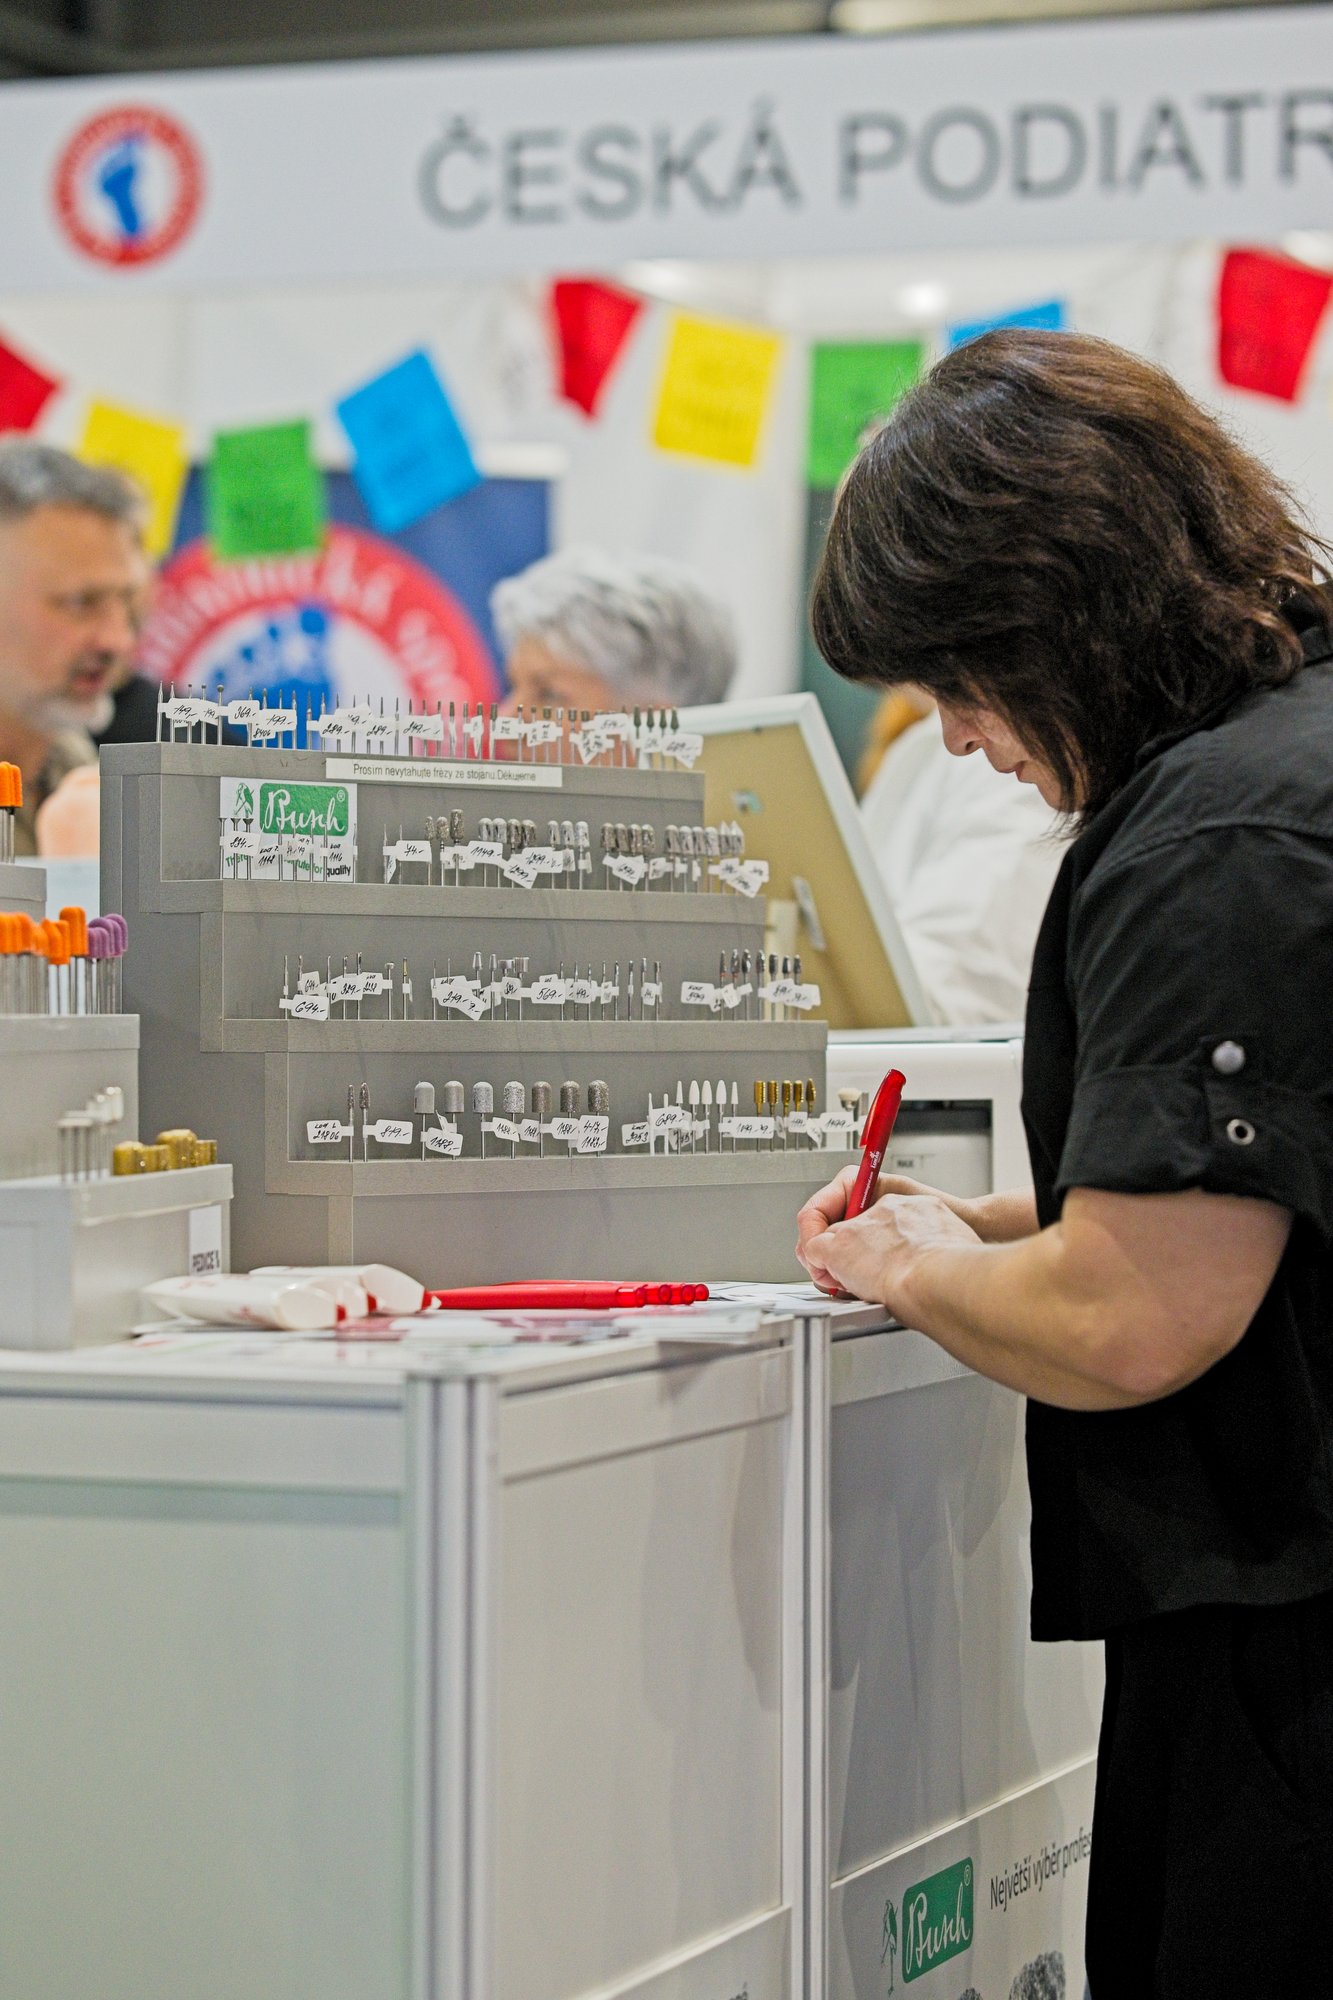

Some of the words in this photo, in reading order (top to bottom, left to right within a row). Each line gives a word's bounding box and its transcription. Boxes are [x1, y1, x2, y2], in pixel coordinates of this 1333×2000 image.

[416, 94, 804, 229] ČESKÁ
[455, 769, 465, 779] ze
[262, 788, 346, 832] Busch
[326, 864, 351, 878] quality
[990, 1854, 1031, 1913] Největší
[1033, 1842, 1062, 1893] výběr
[906, 1881, 971, 1975] Busch
